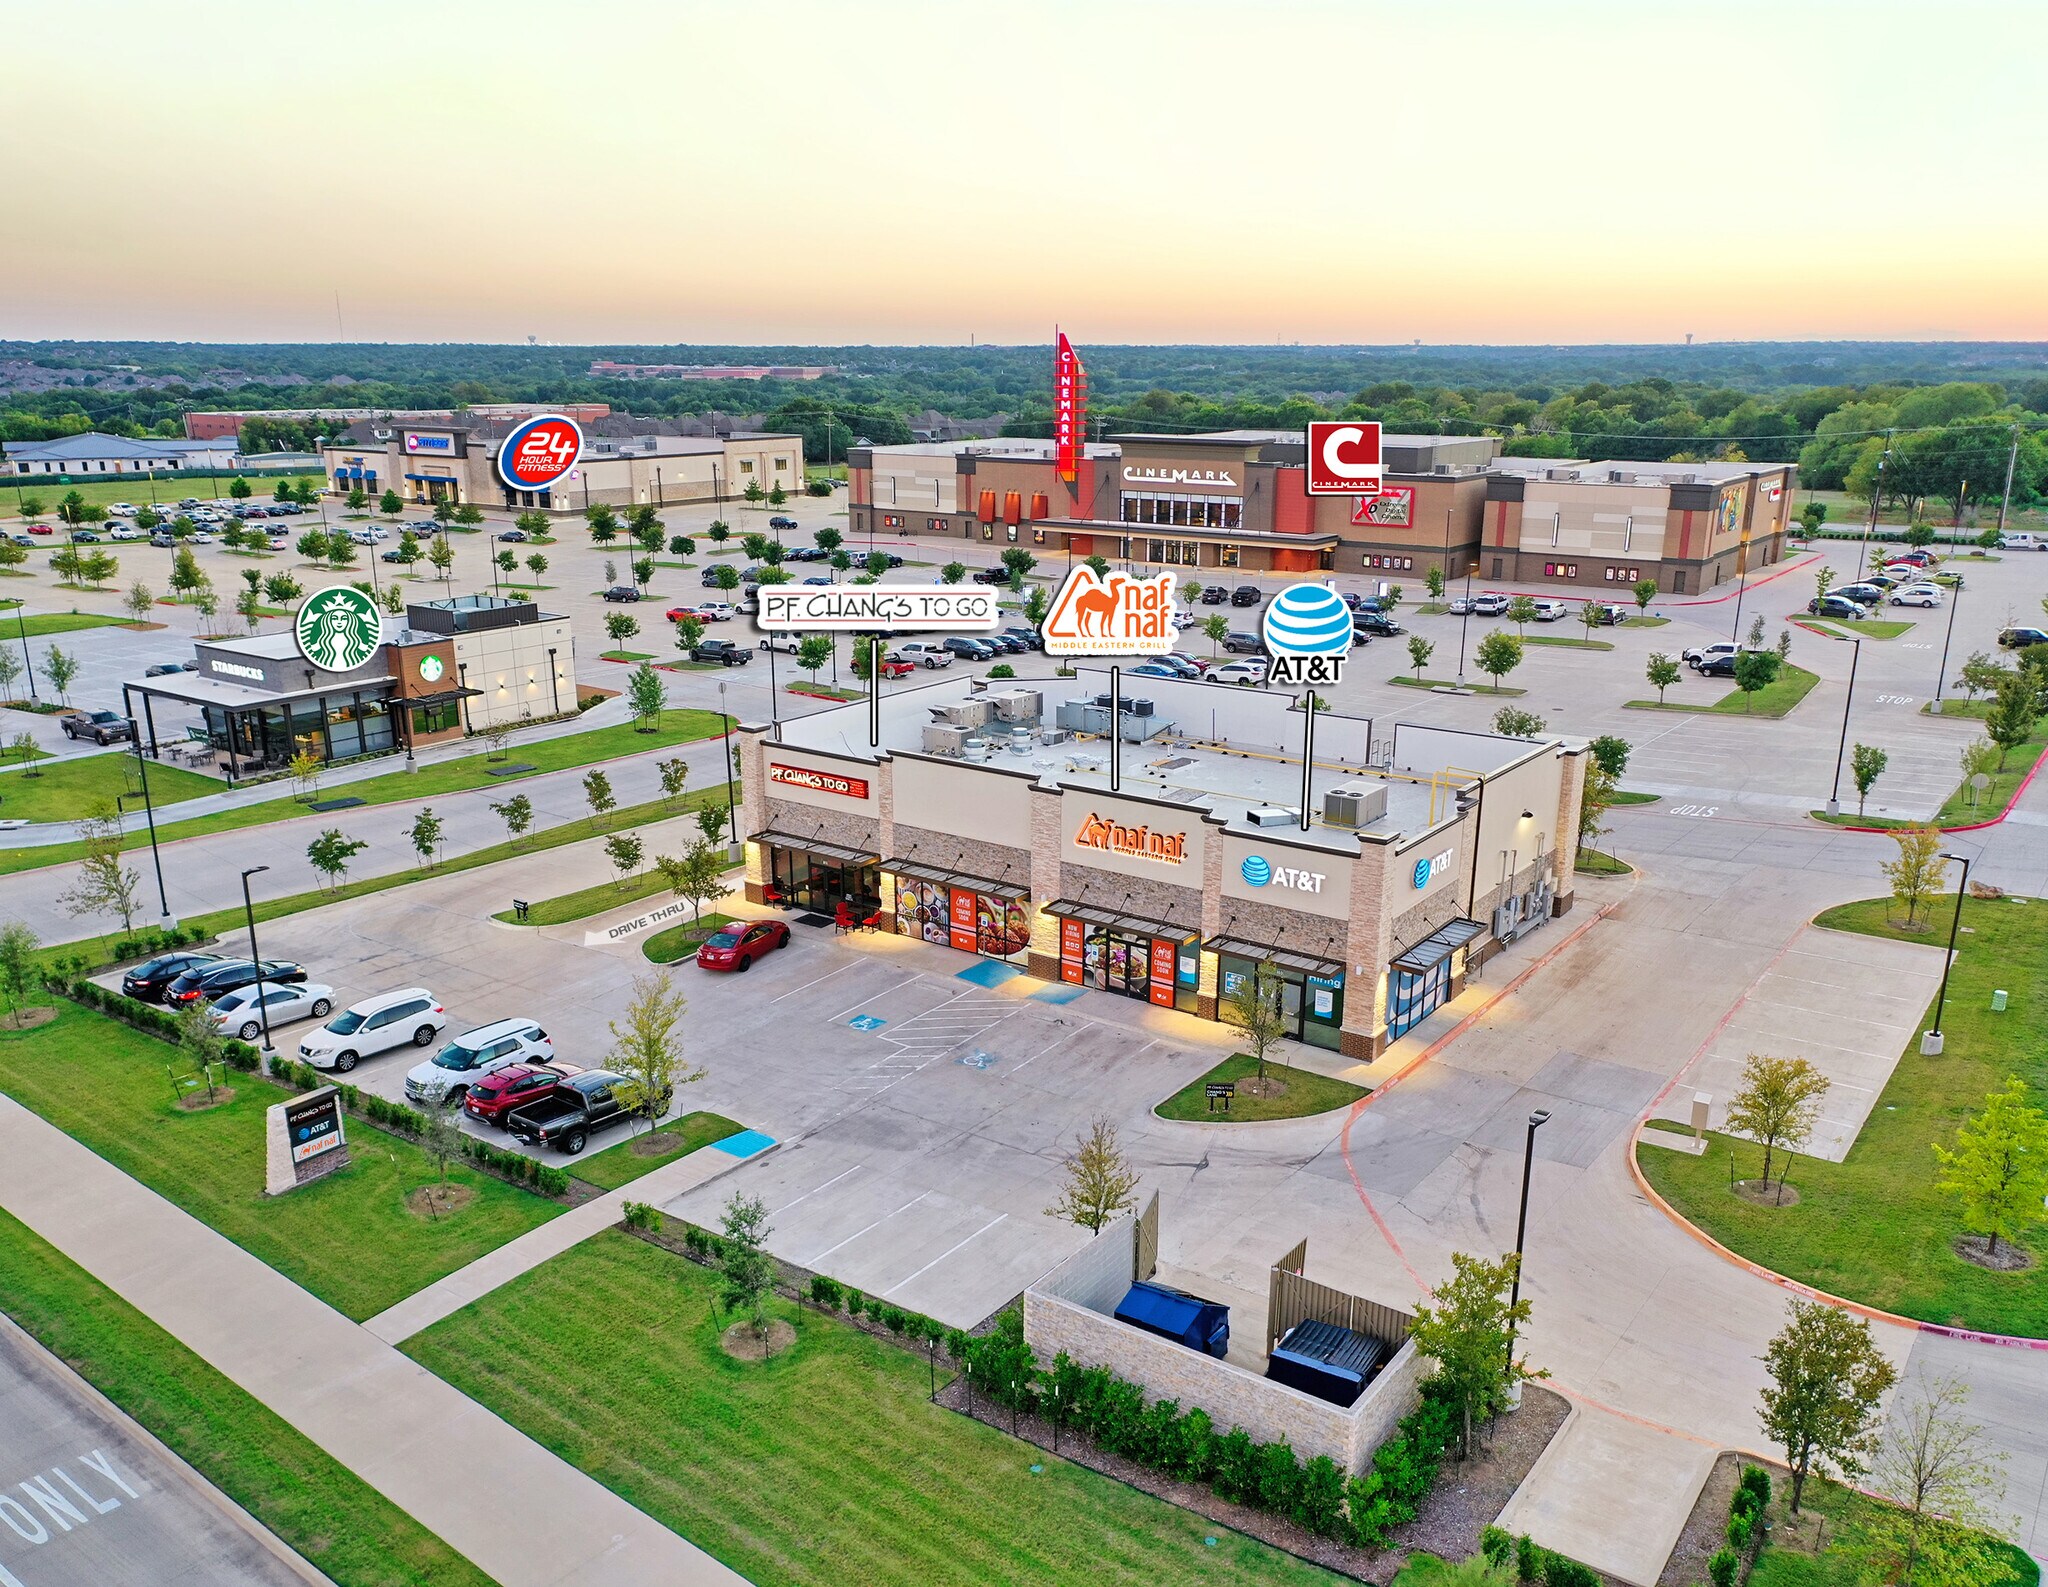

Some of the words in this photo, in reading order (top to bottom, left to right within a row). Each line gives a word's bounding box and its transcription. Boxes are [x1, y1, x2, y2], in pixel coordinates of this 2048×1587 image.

[1060, 351, 1071, 446] CINEMARK
[1123, 466, 1238, 487] CINEMARK
[211, 660, 264, 681] STARBUCKS
[1875, 694, 1914, 705] STOP
[823, 777, 835, 789] TO
[835, 780, 849, 792] GO
[1669, 804, 1719, 817] STOP
[1112, 825, 1149, 851] naf
[1149, 832, 1187, 858] naf
[1428, 848, 1454, 879] AT&T
[1271, 866, 1326, 894] AT&T
[310, 1120, 330, 1135] AT&T
[0, 1448, 140, 1545] ONLY
